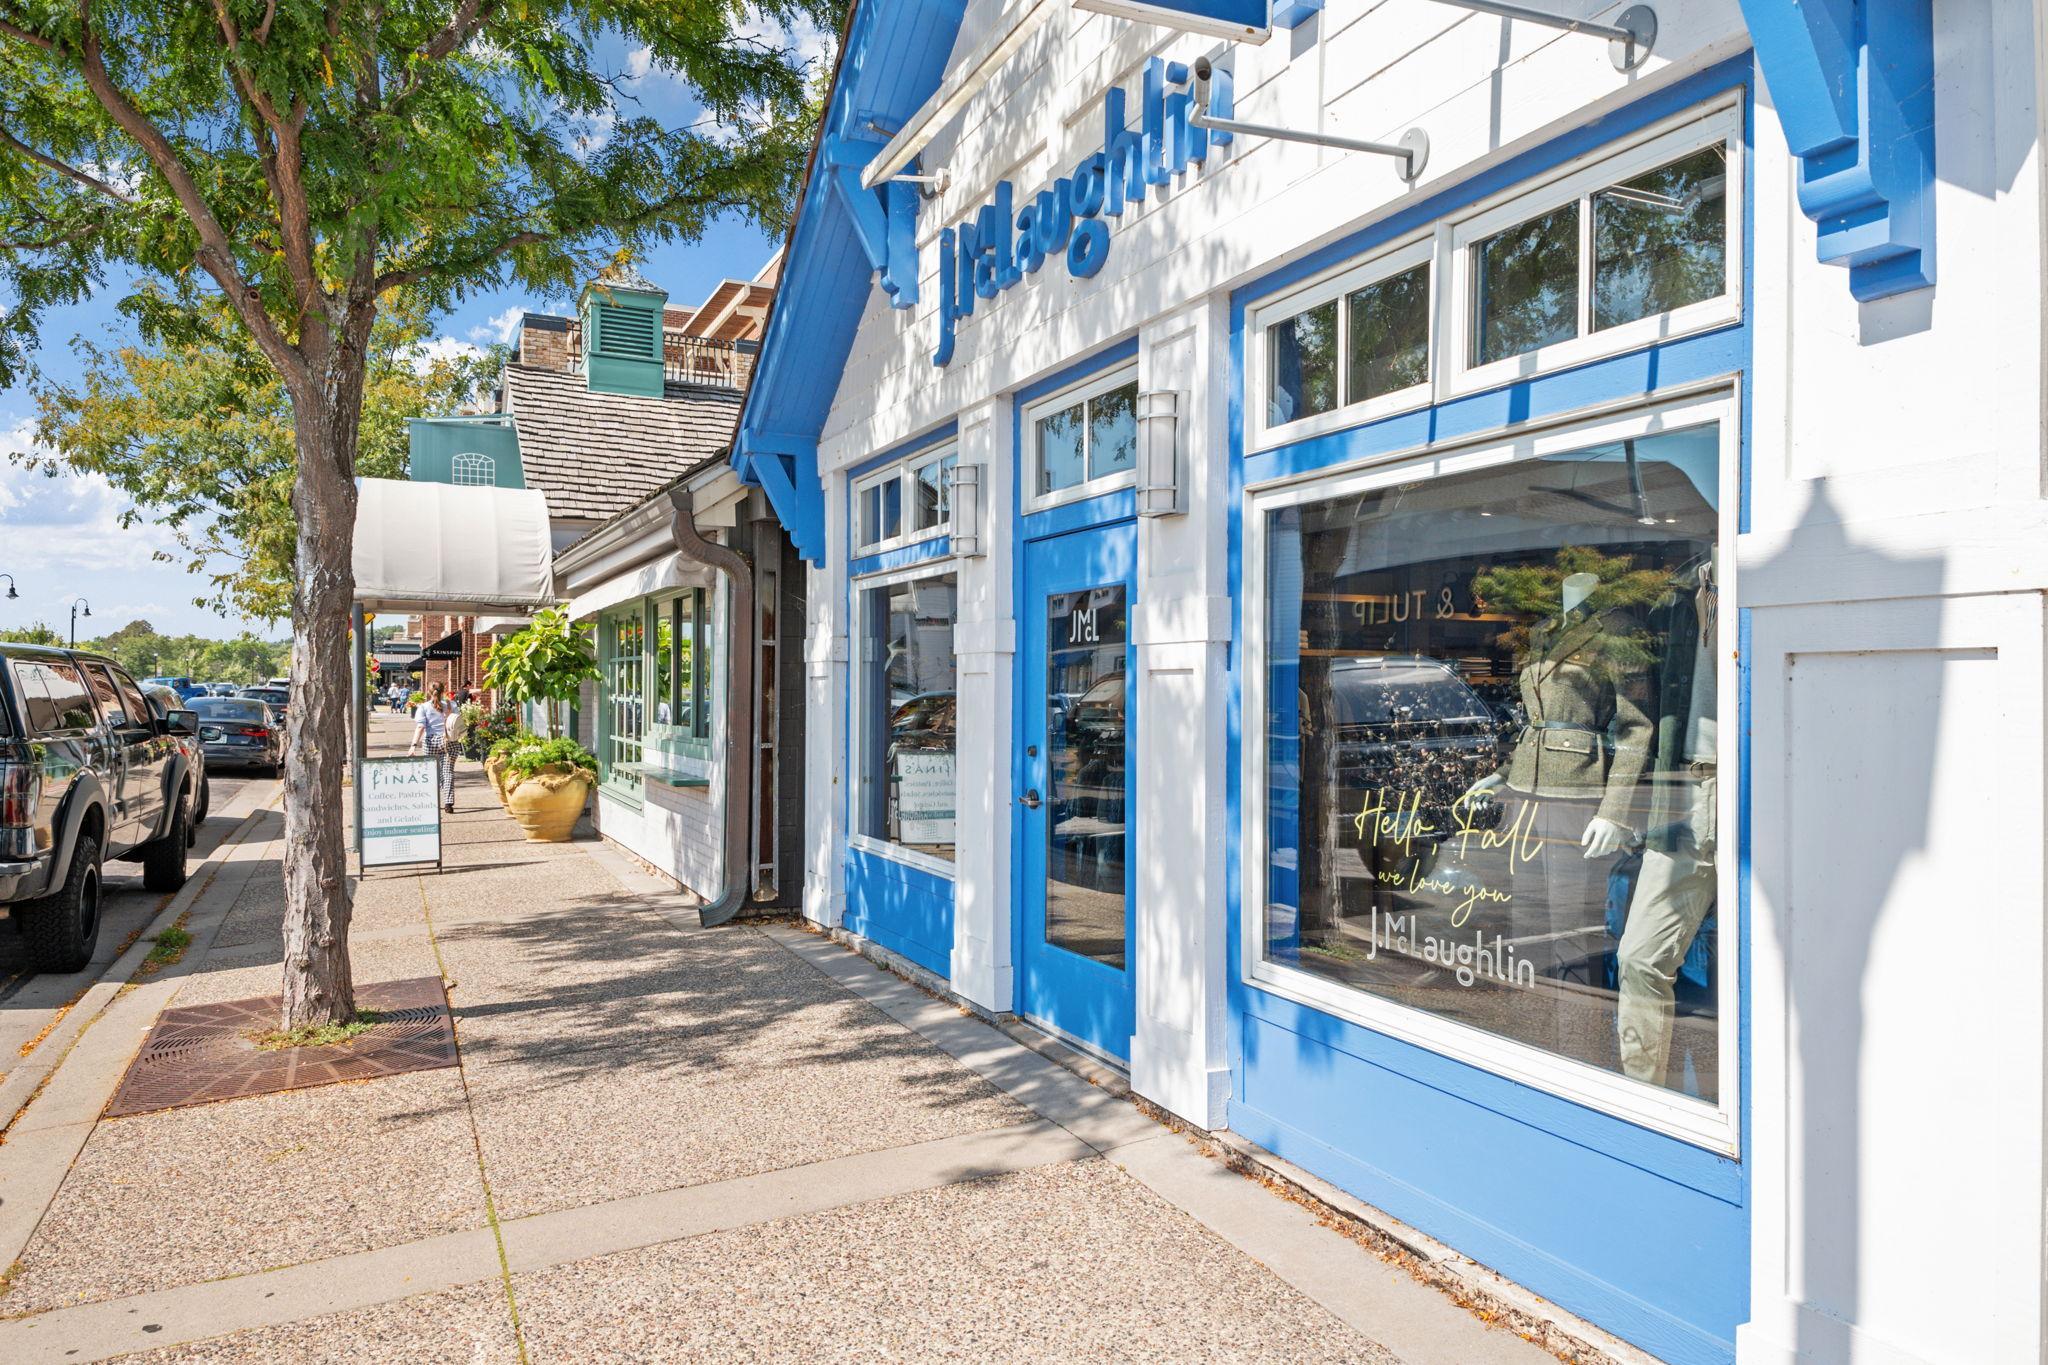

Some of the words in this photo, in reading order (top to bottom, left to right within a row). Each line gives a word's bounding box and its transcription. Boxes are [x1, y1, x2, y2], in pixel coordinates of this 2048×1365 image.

[1354, 787, 1438, 857] Hello,
[1452, 788, 1543, 875] Fall
[1378, 870, 1404, 886] we
[1409, 859, 1455, 894] love
[1451, 885, 1511, 928] you
[1367, 906, 1535, 988] J.McLaughlin
